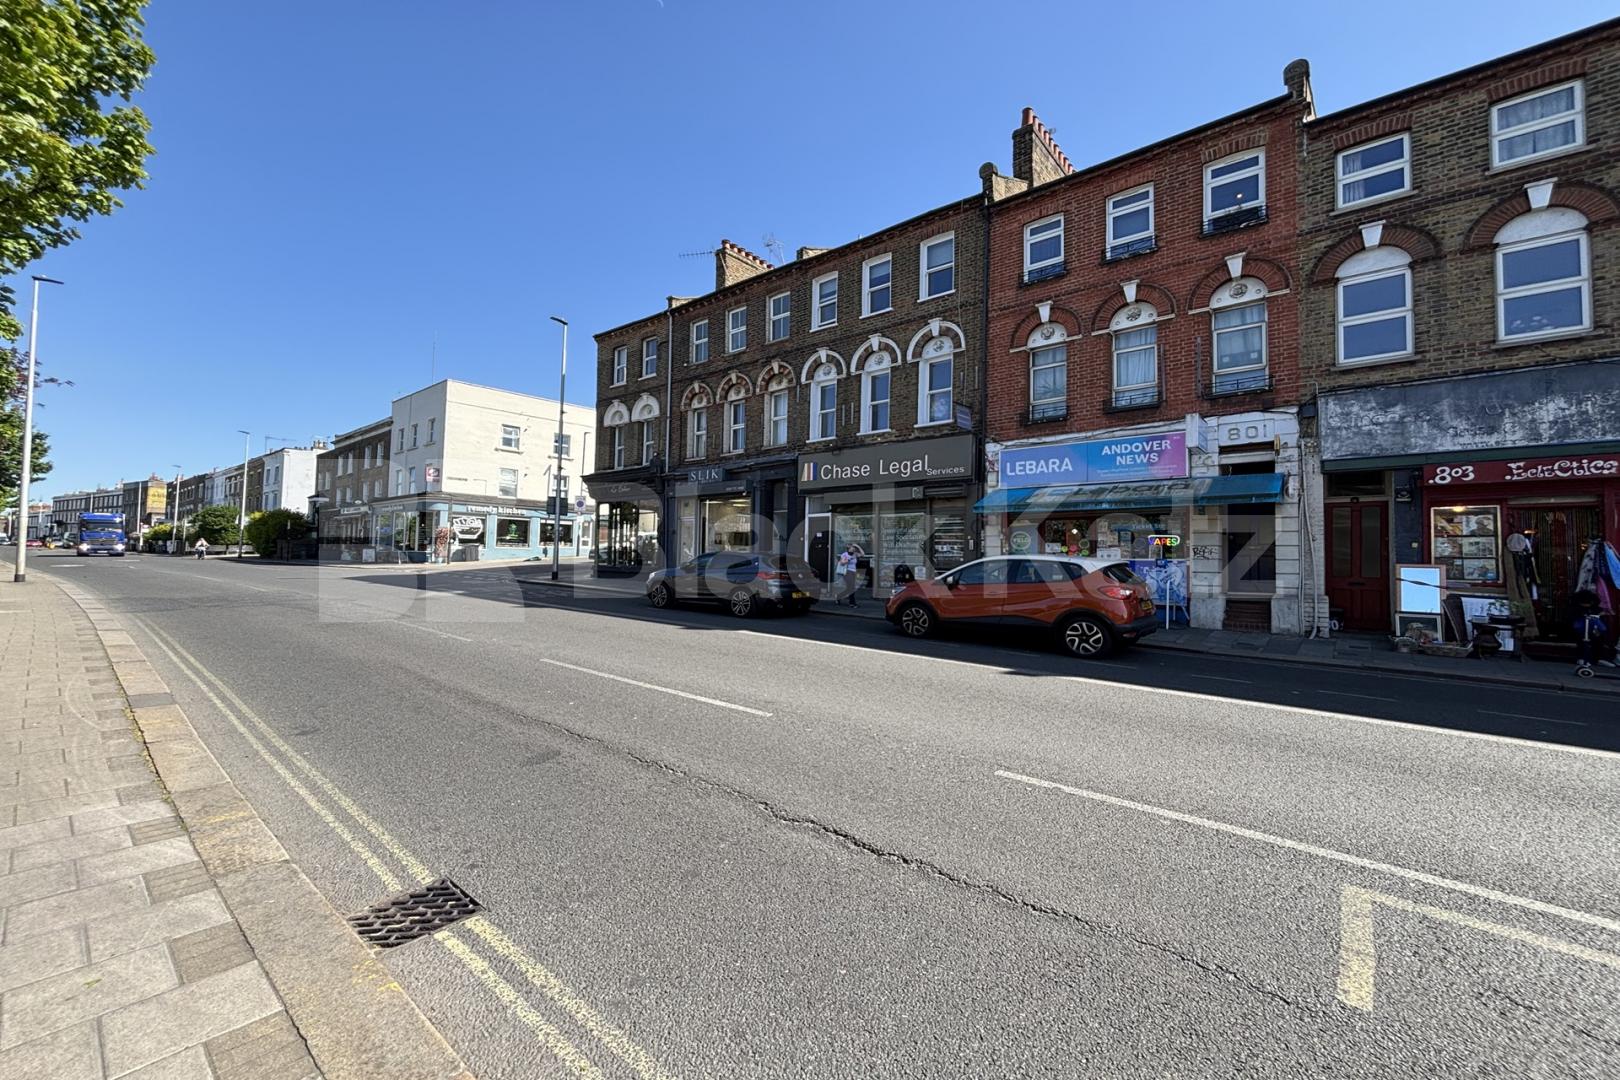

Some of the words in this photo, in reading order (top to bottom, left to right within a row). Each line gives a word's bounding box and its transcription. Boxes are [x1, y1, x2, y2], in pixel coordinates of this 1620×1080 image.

[1227, 423, 1268, 440] 801
[1101, 439, 1172, 456] ANDOVER
[820, 462, 871, 480] Chase
[879, 454, 929, 478] Legal
[926, 465, 965, 476] Services
[1006, 456, 1073, 476] LEBARA
[1115, 452, 1160, 466] NEWS
[690, 469, 719, 481] SLIK
[1148, 537, 1178, 547] VAPES
